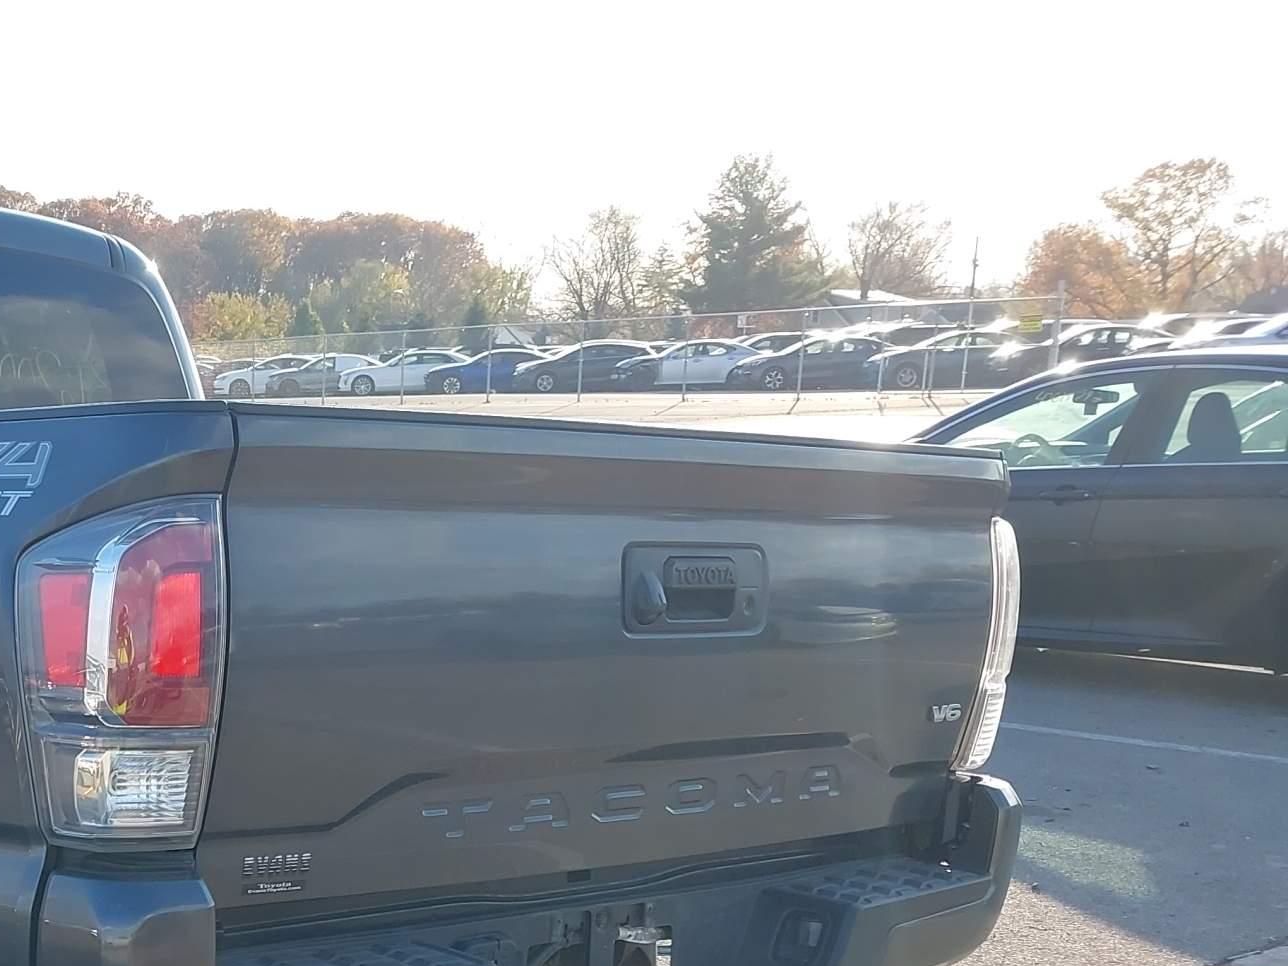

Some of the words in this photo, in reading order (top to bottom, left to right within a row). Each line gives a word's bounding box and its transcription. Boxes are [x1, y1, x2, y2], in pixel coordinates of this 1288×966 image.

[674, 566, 736, 585] TOYOTA
[932, 703, 962, 723] V6
[419, 764, 842, 838] TACOMA
